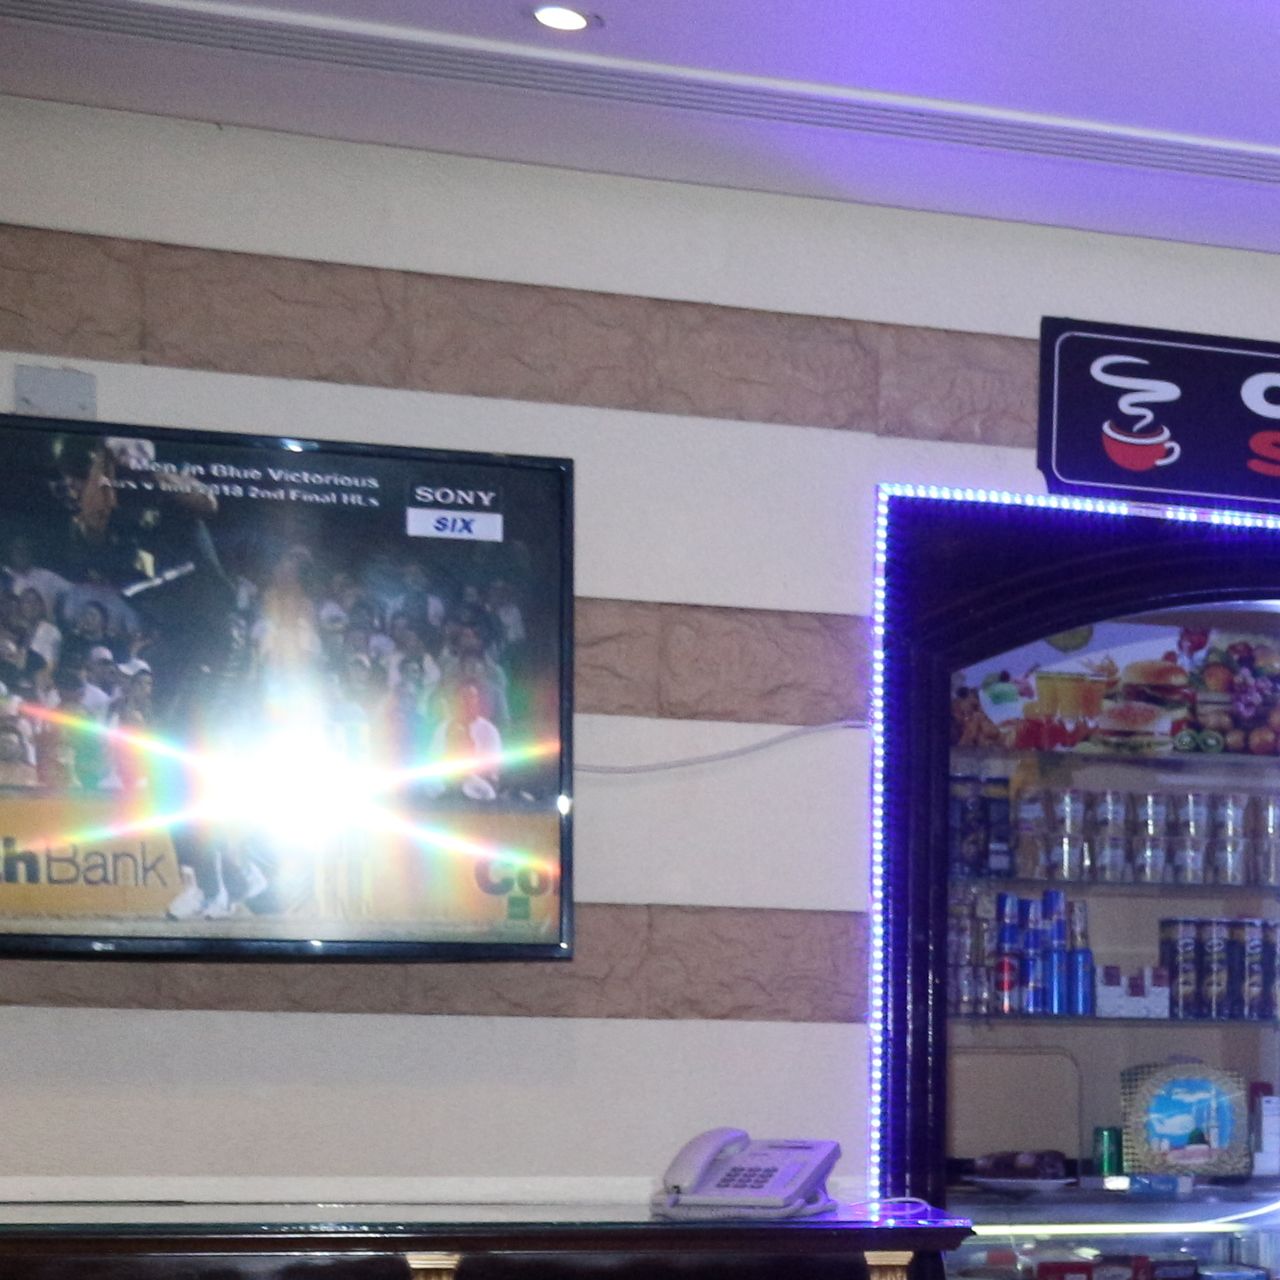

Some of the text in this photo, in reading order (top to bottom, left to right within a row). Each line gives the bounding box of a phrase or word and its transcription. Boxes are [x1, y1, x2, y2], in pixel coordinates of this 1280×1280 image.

[209, 462, 262, 480] Blue
[266, 467, 380, 489] Victorious
[288, 488, 337, 504] Final
[414, 485, 497, 507] SONY
[432, 516, 475, 534] SIX
[0, 836, 168, 887] hBank
